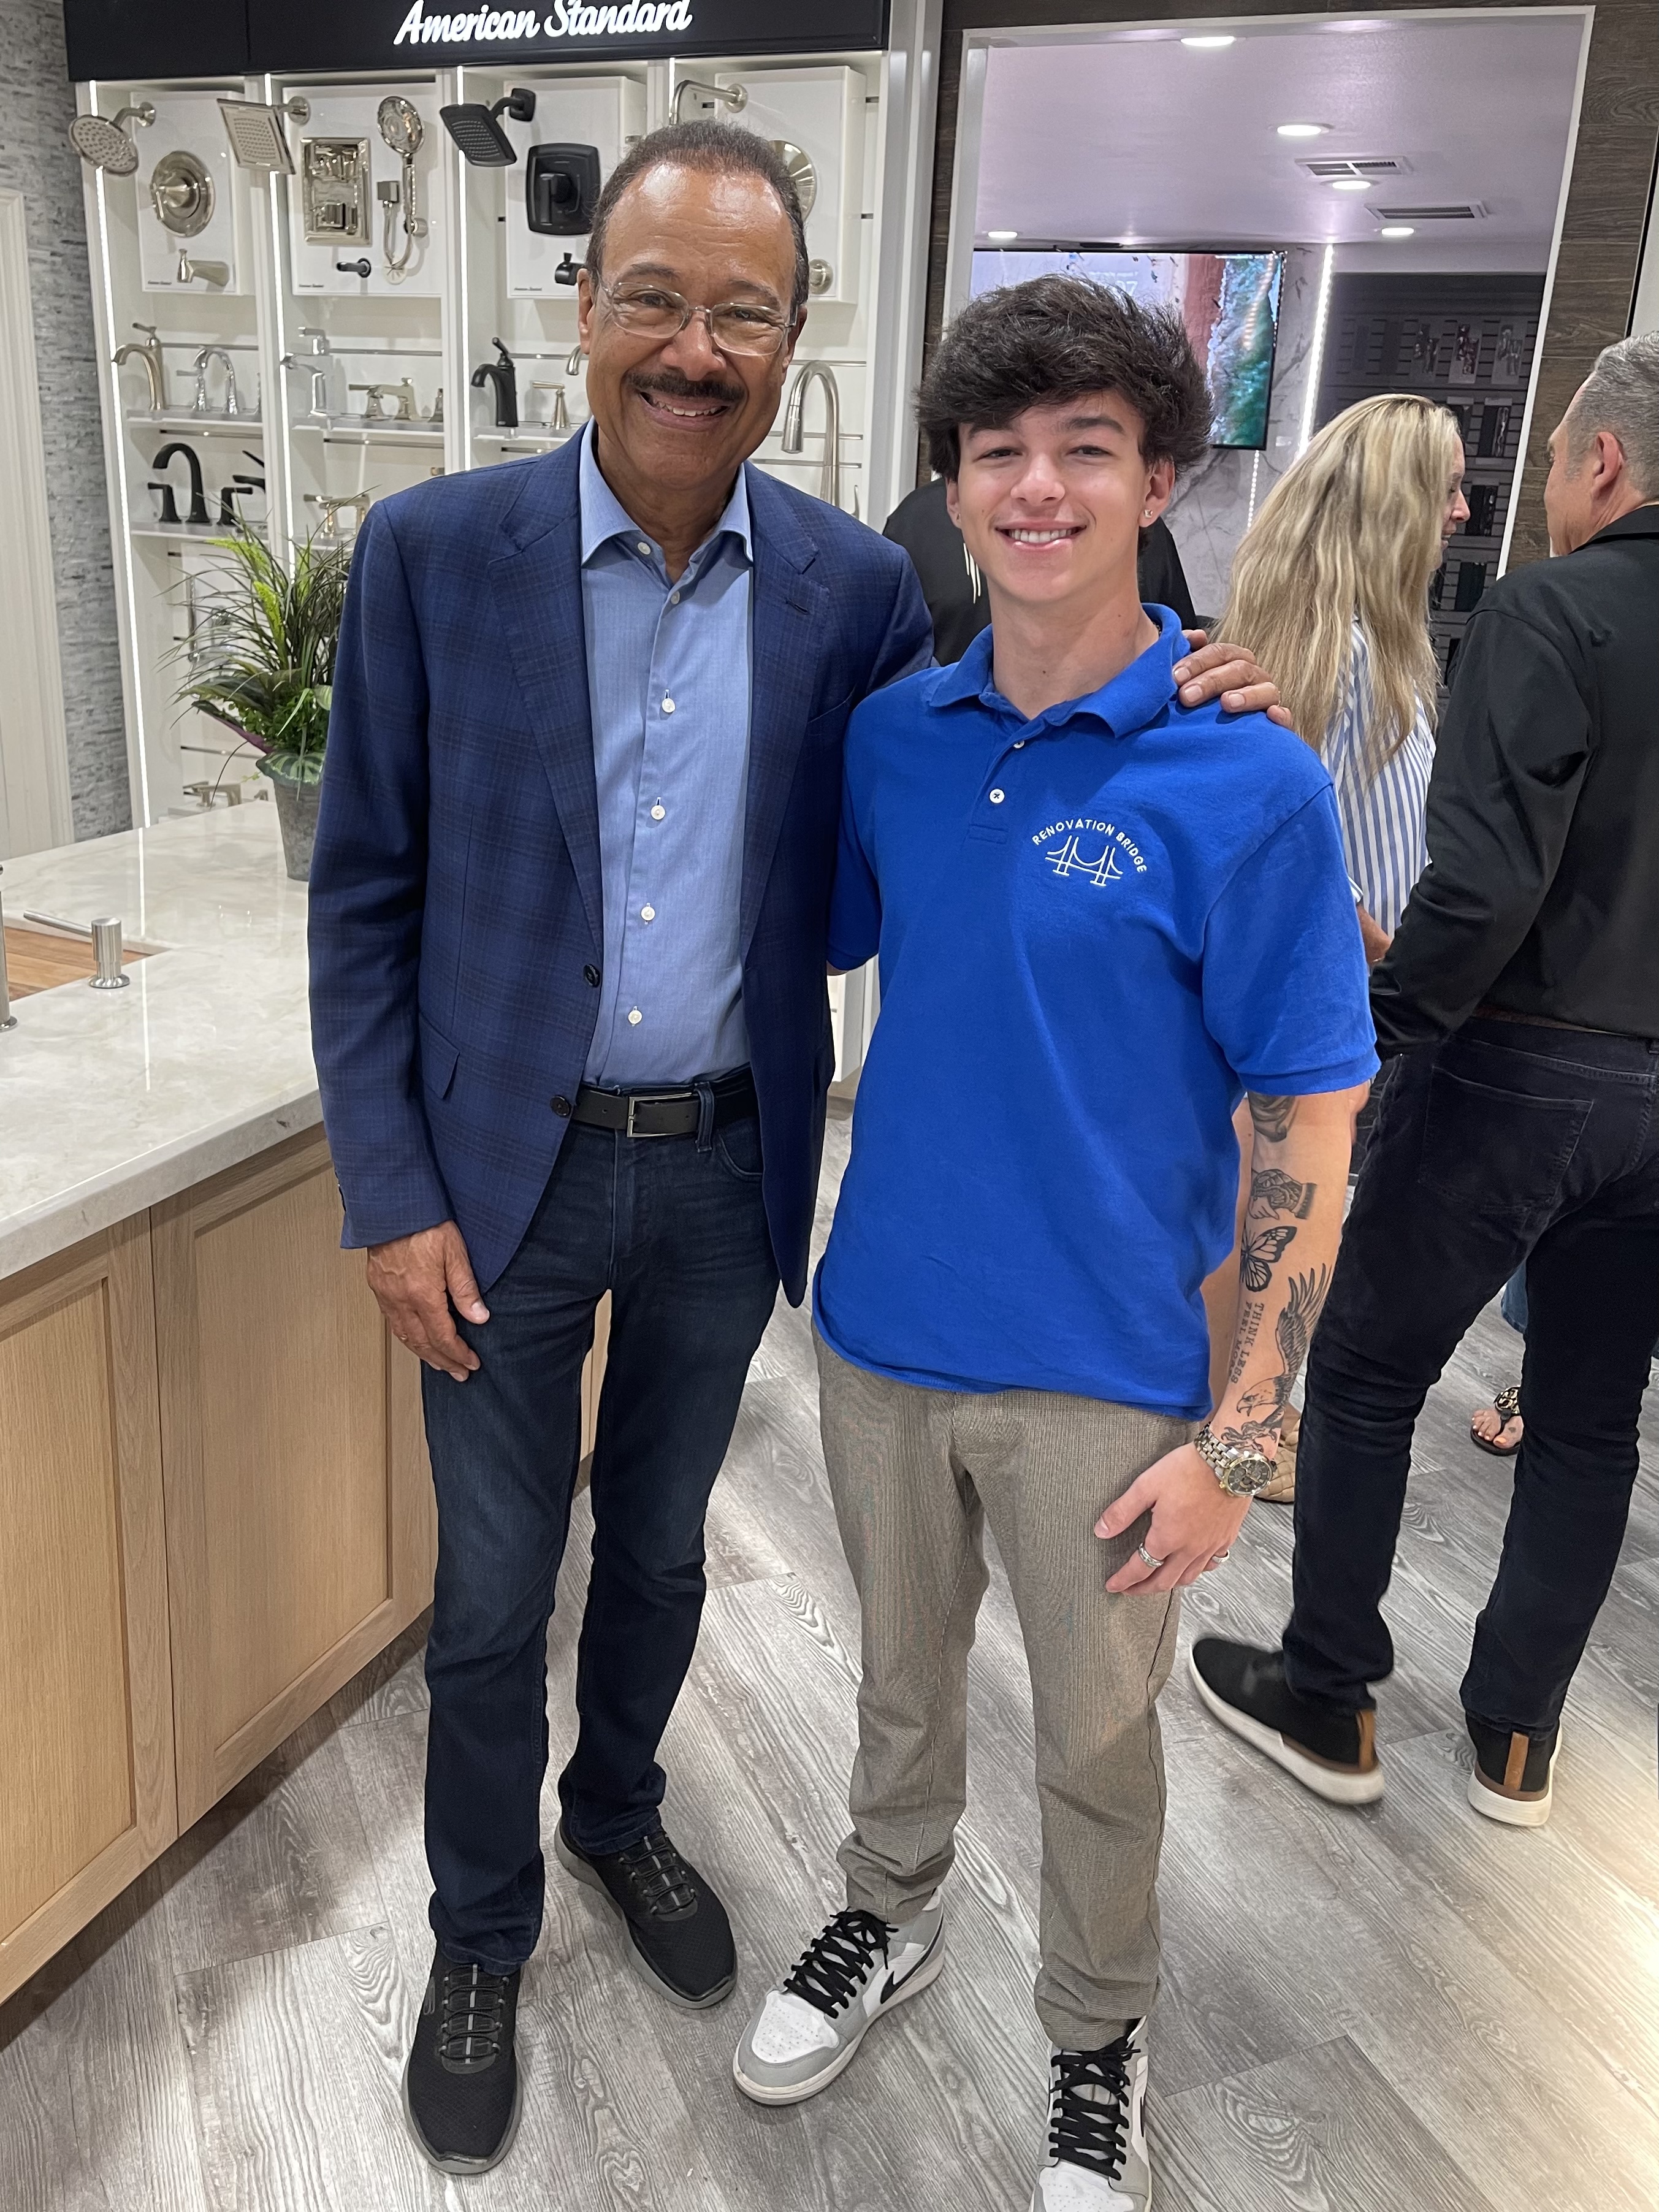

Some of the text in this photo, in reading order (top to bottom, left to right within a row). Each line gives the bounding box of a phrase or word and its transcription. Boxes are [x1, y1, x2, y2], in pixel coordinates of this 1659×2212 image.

[394, 0, 692, 45] American Standard
[1032, 818, 1147, 873] RENOVATION BRIDGE
[1239, 1301, 1253, 1335] FEEL
[1231, 1303, 1264, 1384] THINK LESS
